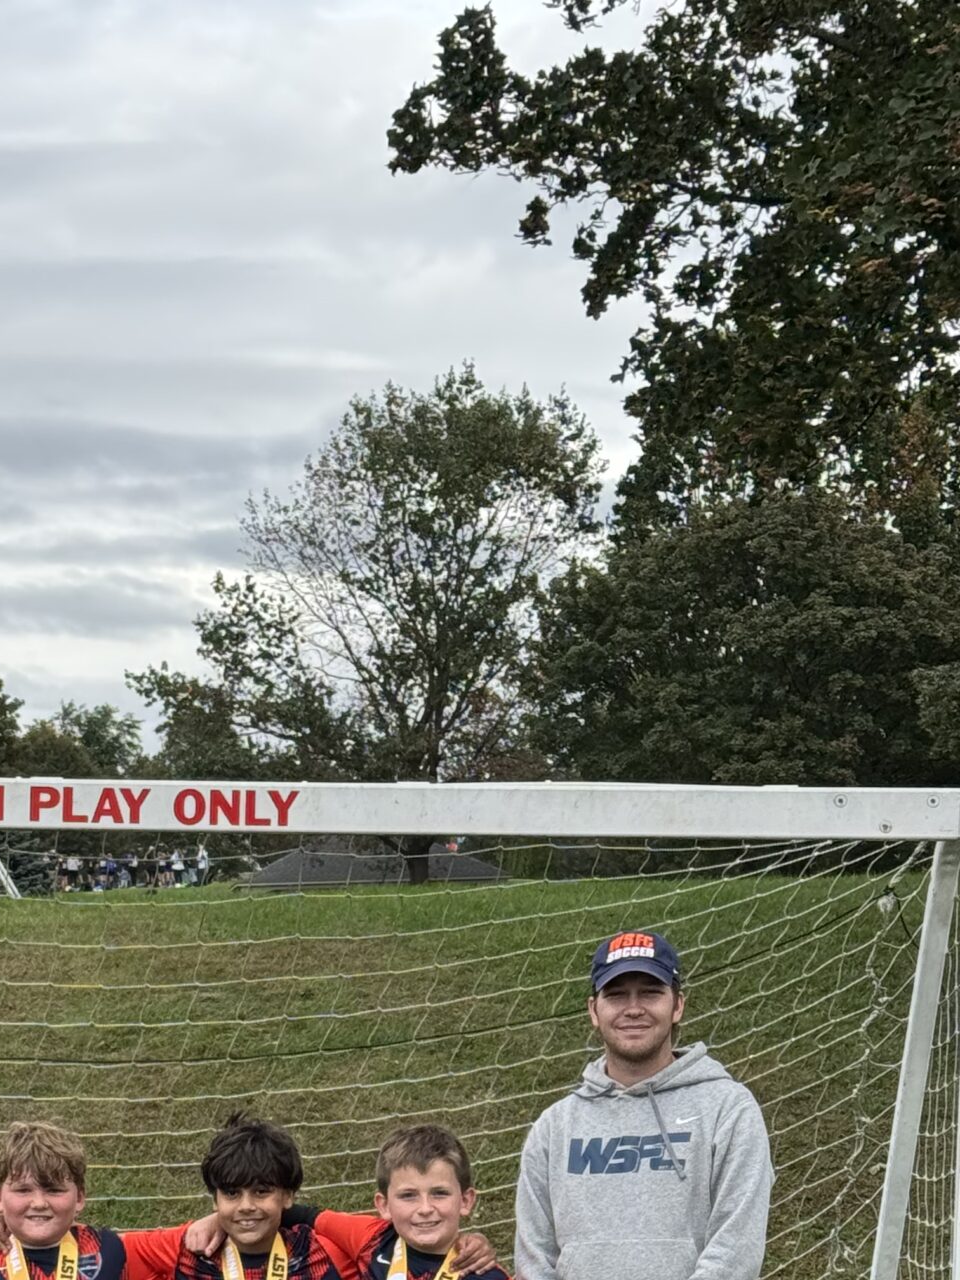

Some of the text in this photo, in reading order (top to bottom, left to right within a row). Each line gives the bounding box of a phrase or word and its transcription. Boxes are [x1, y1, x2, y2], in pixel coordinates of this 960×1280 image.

[29, 785, 151, 824] PLAY
[173, 788, 300, 827] ONLY
[606, 946, 655, 963] SOCCER
[608, 933, 654, 952] WSFC
[567, 1131, 692, 1175] WSFC
